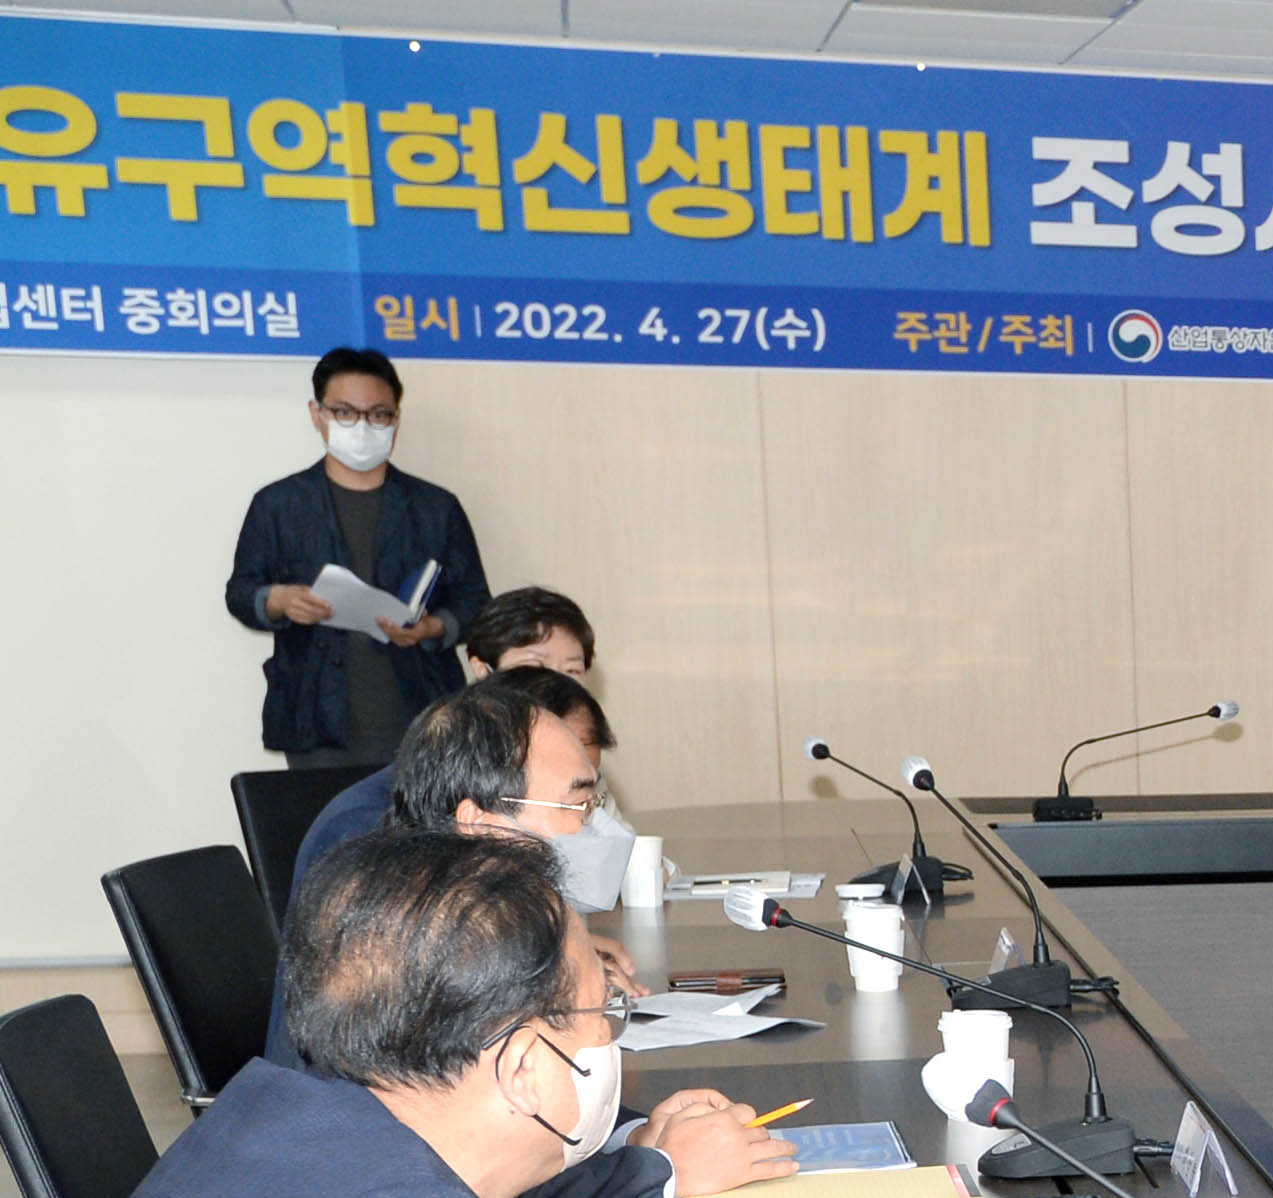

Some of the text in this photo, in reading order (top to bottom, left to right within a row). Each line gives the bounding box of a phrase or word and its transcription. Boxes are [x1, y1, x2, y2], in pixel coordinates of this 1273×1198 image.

[0, 85, 992, 247] 유구역혁신생태계
[119, 288, 301, 338] 중회의실
[374, 295, 827, 352] 일시 2022. 4. 27(수)
